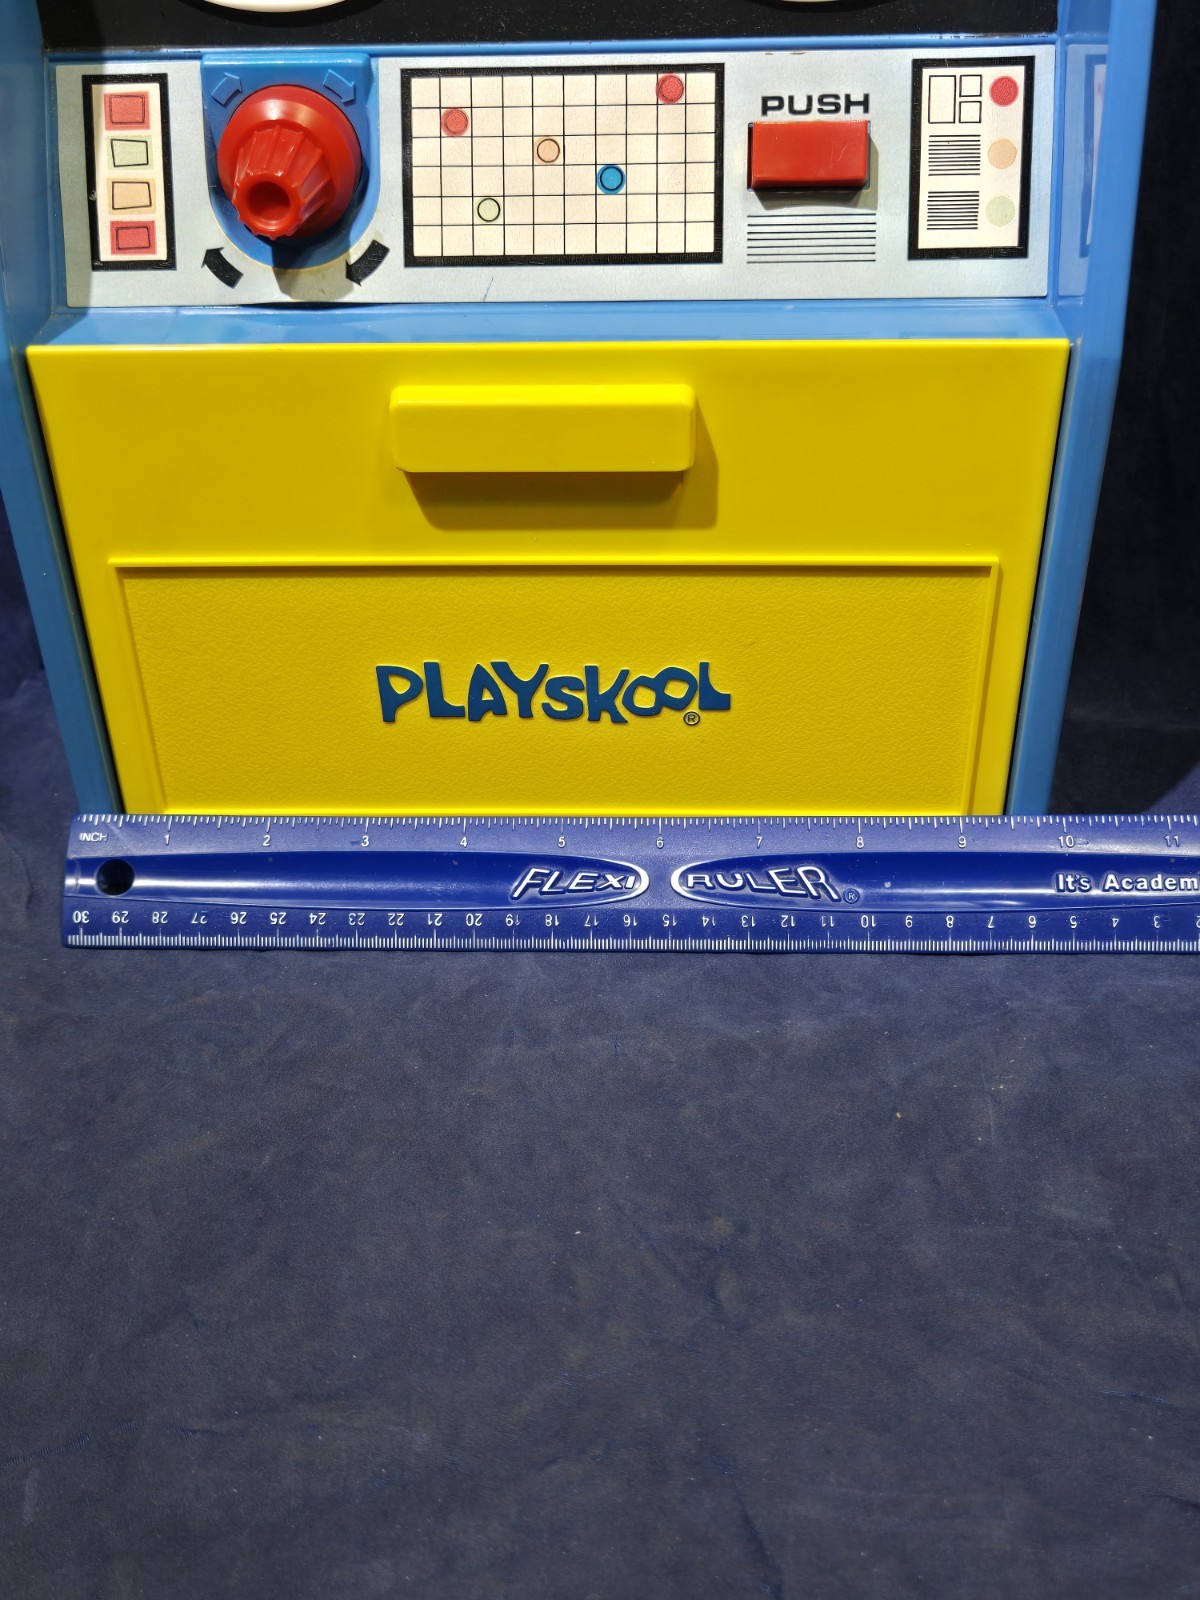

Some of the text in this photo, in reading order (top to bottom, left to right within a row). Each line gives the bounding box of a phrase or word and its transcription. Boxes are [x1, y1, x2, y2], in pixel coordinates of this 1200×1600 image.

[761, 93, 870, 117] PUSH
[376, 662, 731, 723] PLAYSKOOL
[79, 832, 1179, 849] INCH 1 2 3 4 5 6 7 8 9 10 11
[511, 866, 841, 900] FLEXI RULER
[1057, 873, 1199, 892] It's Academ
[73, 911, 89, 923] 30
[111, 911, 129, 923] 29
[151, 911, 168, 924] 28
[191, 911, 207, 924] 27
[231, 912, 247, 924] 26
[270, 912, 286, 924] 25
[309, 912, 326, 925] 24
[348, 913, 365, 925] 23
[388, 913, 405, 926] 22
[427, 913, 442, 926] 21
[466, 913, 483, 926] 20
[506, 914, 522, 926] 19
[545, 915, 560, 926] 18
[585, 915, 599, 926] 17
[623, 915, 638, 926] 16
[662, 915, 677, 927] 15
[702, 915, 716, 927] 14
[741, 915, 755, 927] 13
[781, 915, 795, 927] 12
[821, 915, 834, 927] 11
[861, 915, 876, 927] 10
[905, 915, 913, 928] 9
[946, 915, 954, 928] 8
[988, 915, 995, 928] 7
[1028, 915, 1036, 929] 6
[1070, 915, 1077, 929] 5
[1112, 917, 1119, 928] 4
[1153, 915, 1160, 928] 3
